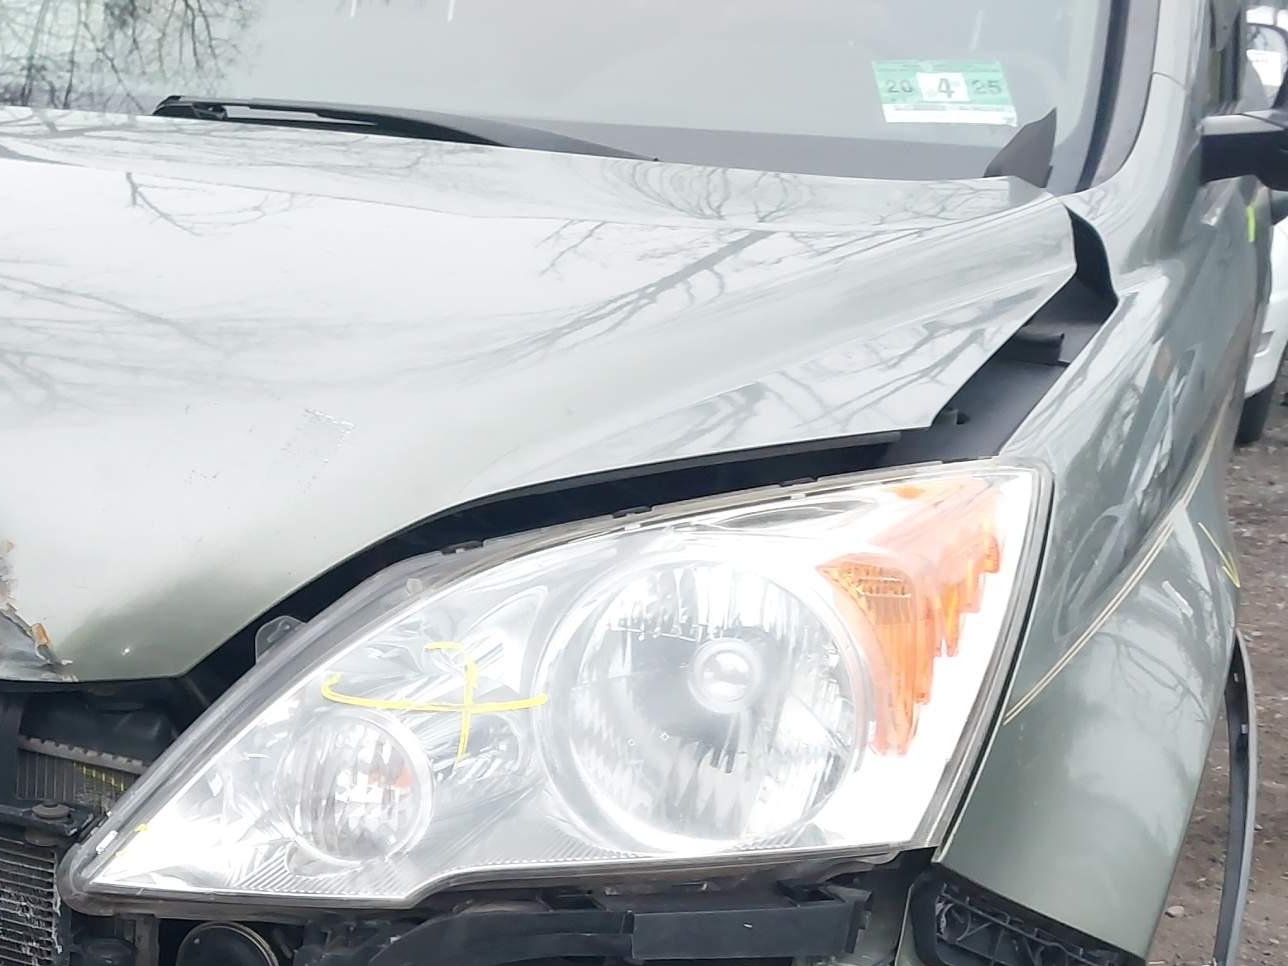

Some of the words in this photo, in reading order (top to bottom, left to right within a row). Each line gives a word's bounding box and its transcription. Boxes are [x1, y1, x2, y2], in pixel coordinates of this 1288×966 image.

[886, 79, 914, 94] 20
[937, 77, 955, 99] 4
[972, 79, 1002, 95] 25
